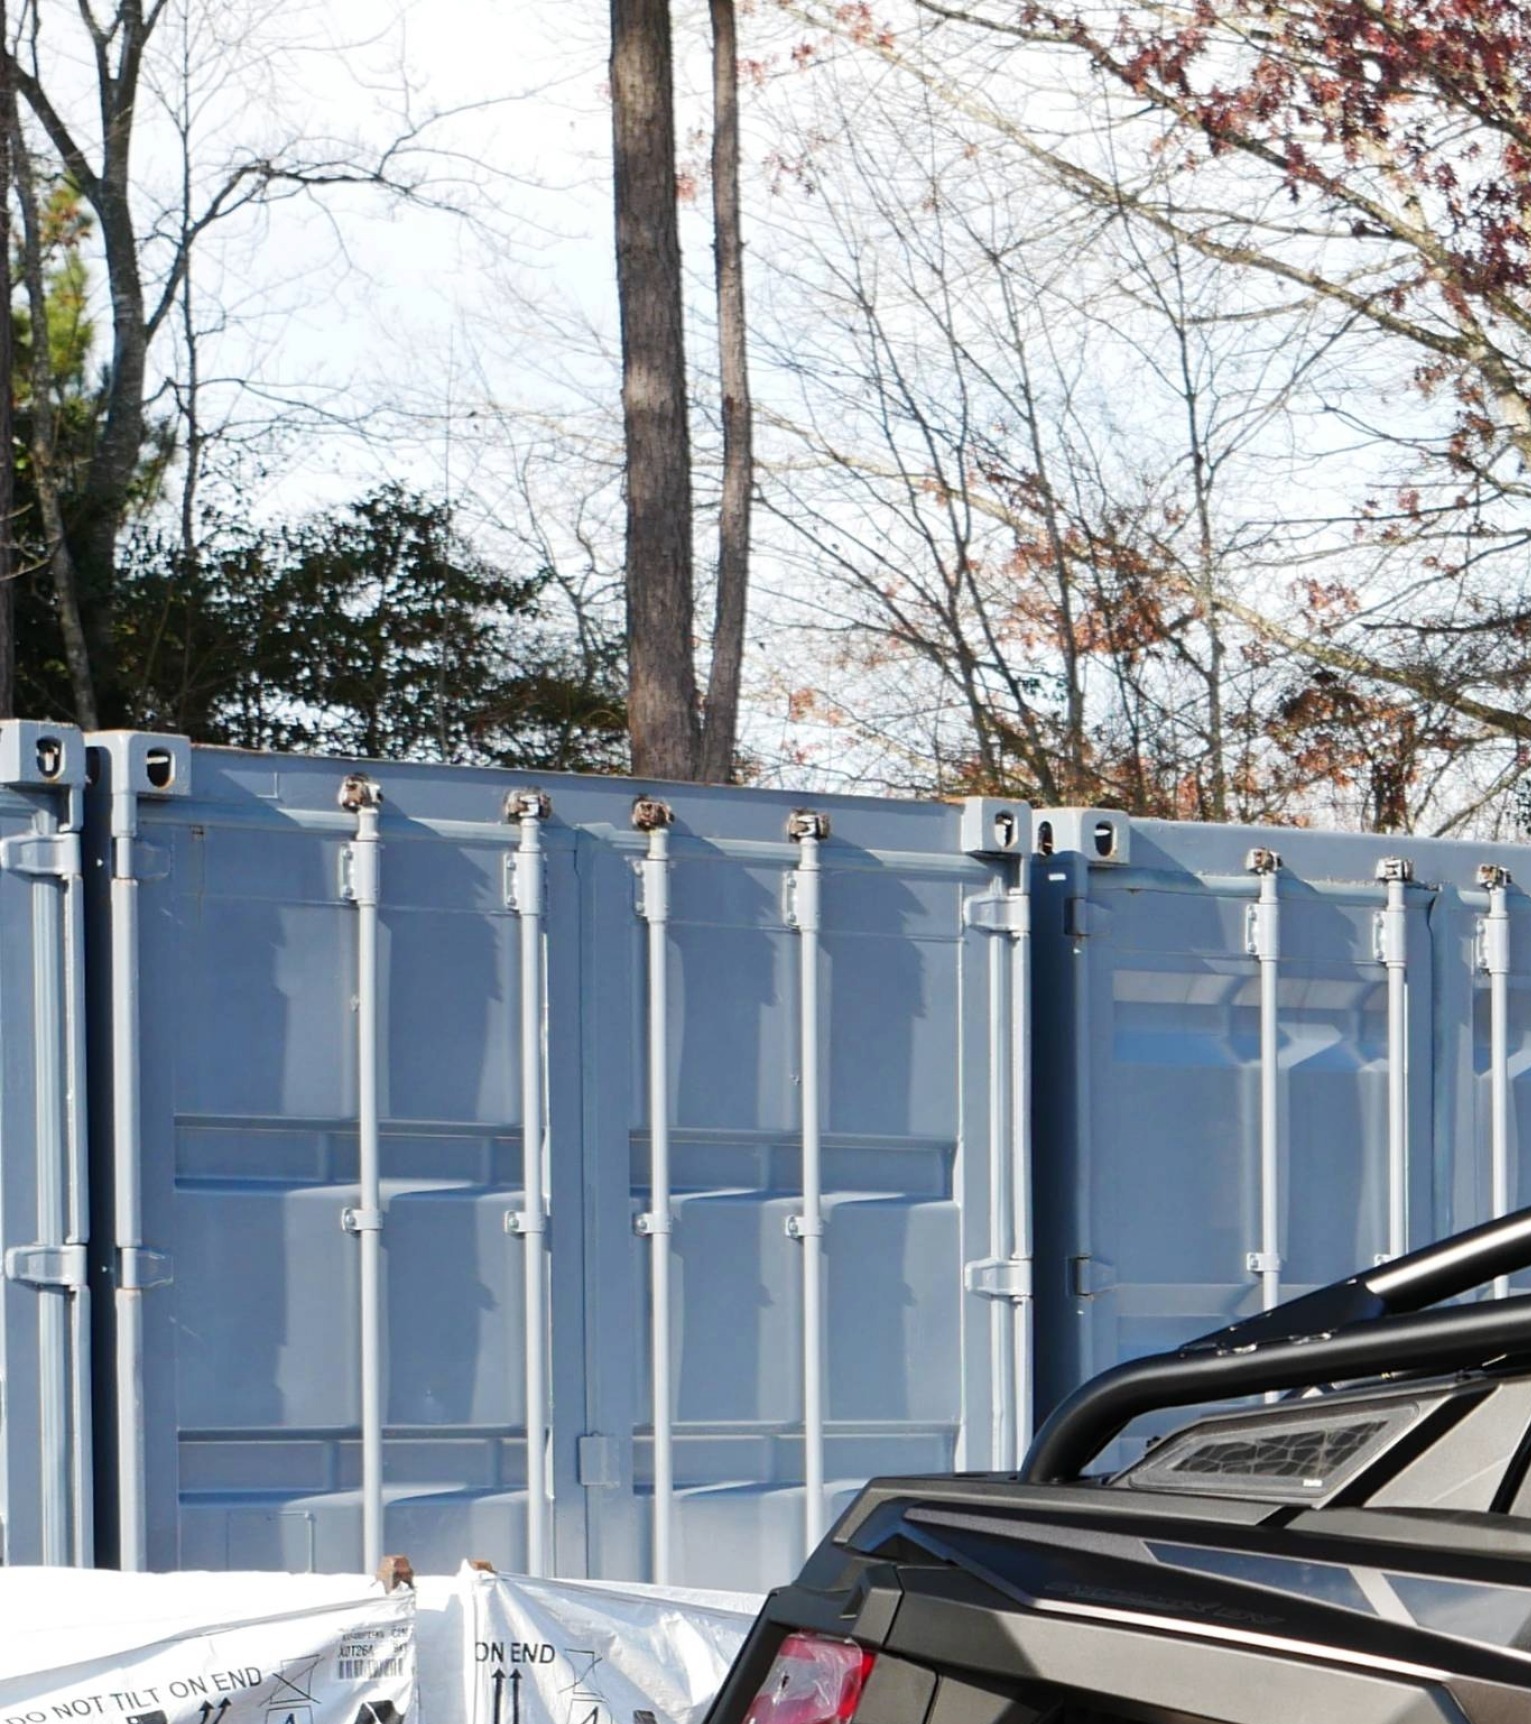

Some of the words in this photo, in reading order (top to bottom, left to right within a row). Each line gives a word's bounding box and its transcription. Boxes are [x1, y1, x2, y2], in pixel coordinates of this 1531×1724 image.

[475, 1642, 504, 1663] ON
[510, 1642, 555, 1663] END
[52, 1695, 103, 1719] NOT
[109, 1689, 161, 1711] TILT
[168, 1676, 208, 1699] ON
[210, 1667, 263, 1691] END
